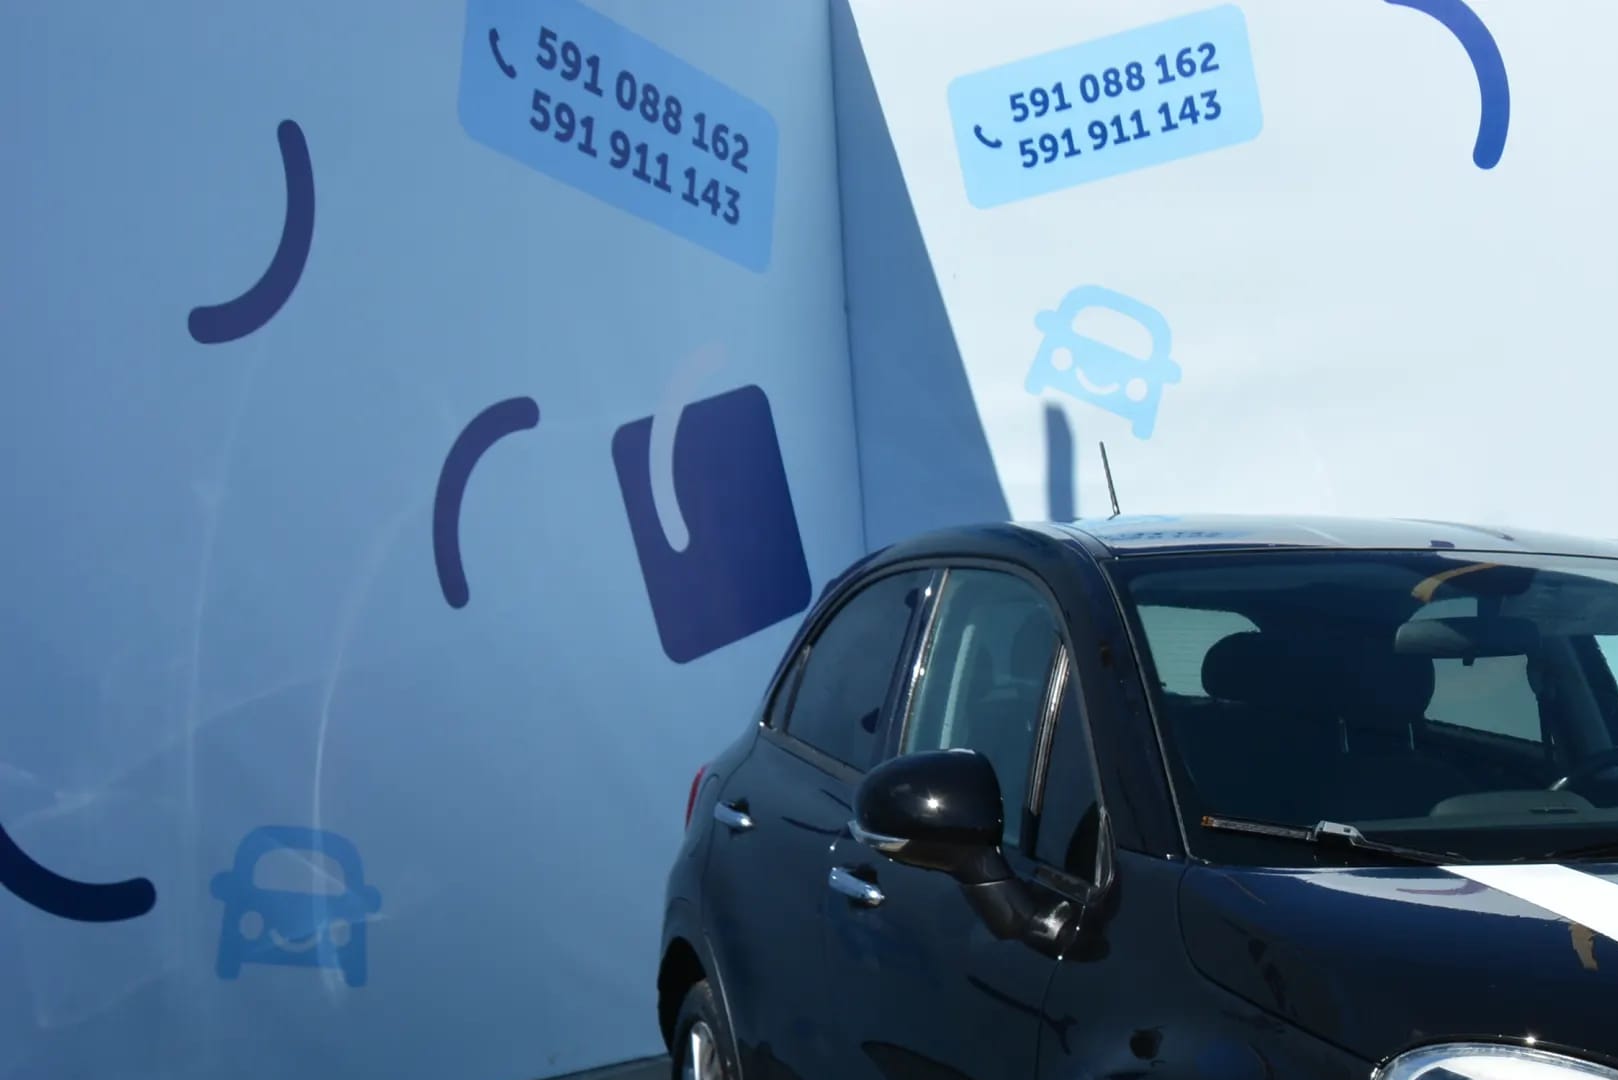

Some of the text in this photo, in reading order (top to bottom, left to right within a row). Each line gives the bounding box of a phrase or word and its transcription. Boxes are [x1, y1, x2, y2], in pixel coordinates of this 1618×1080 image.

[536, 26, 749, 174] 591 088 162
[1009, 42, 1220, 123] 591 088 162
[1018, 89, 1222, 169] 591 911 143
[529, 88, 741, 226] 591 911 143
